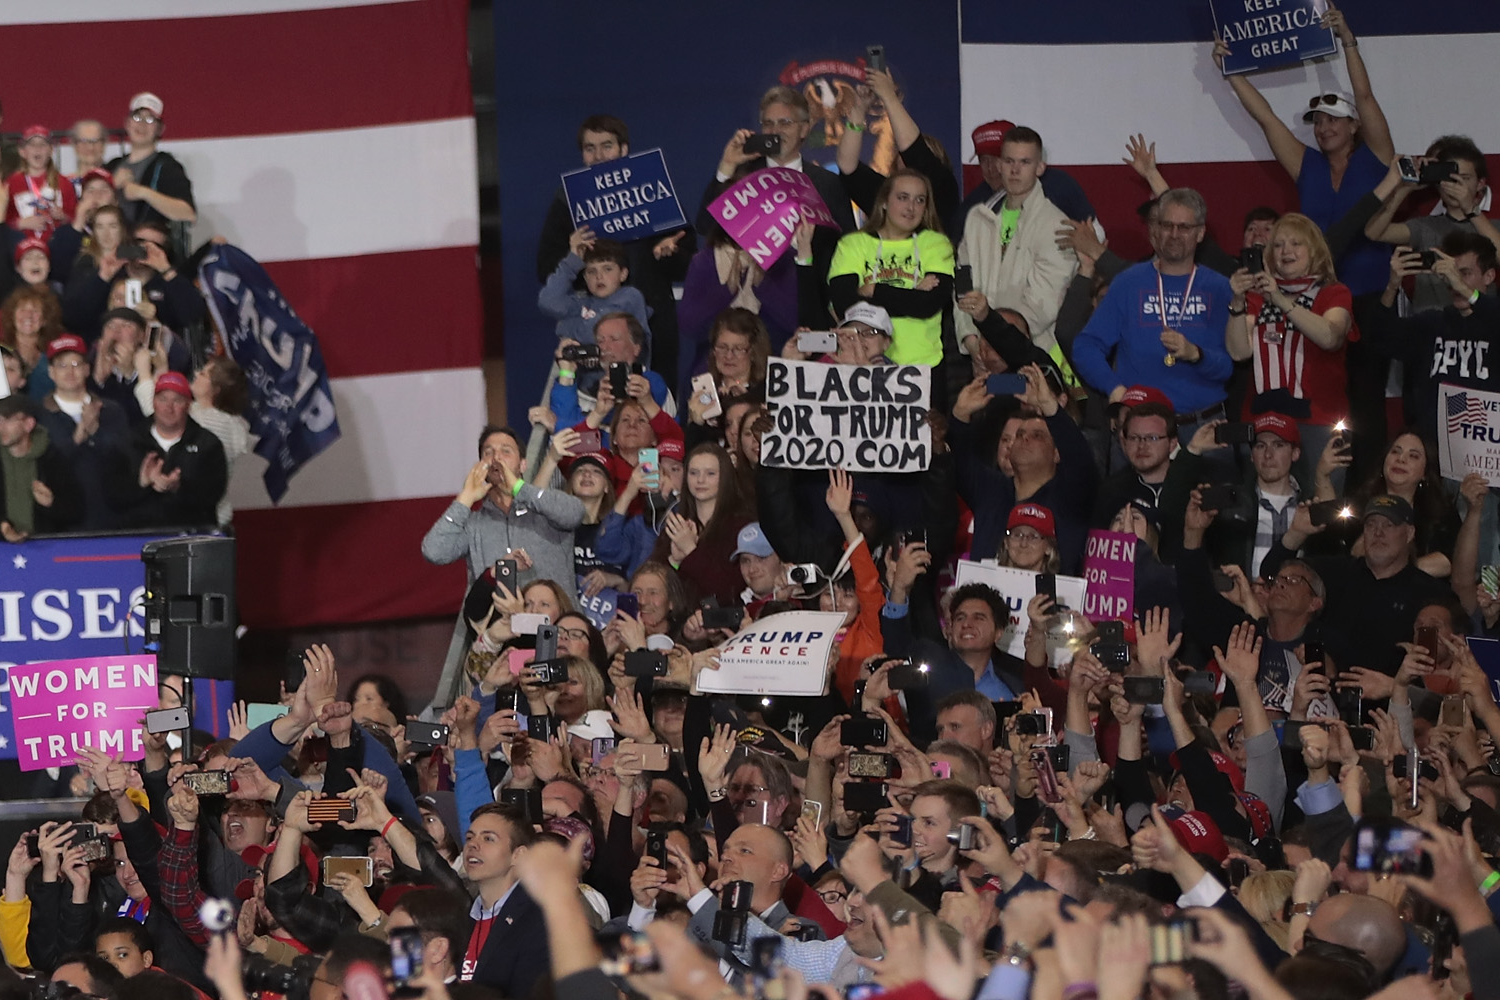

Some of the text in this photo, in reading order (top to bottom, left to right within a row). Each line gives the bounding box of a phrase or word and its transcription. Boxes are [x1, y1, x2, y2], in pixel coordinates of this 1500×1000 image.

[1221, 5, 1324, 42] AMERICA
[1251, 36, 1299, 58] GREAT
[594, 168, 632, 191] KEEP
[575, 179, 673, 223] AMERICA
[722, 170, 810, 221] TRUMP
[603, 210, 651, 234] GREAT
[1143, 302, 1207, 315] SWAMP
[1148, 295, 1180, 304] DIN
[768, 362, 923, 403] BLACKS
[769, 404, 929, 441] FOR TRUMP
[1460, 422, 1500, 444] TRU
[762, 436, 927, 469] 2020.COM
[1086, 536, 1136, 563] OMEN
[1085, 567, 1108, 585] FOR
[580, 594, 612, 615] EEP
[1085, 594, 1128, 618] UMP
[723, 645, 808, 657] PENCE
[726, 631, 824, 647] TRUMP
[10, 663, 156, 698] WOMEN
[57, 702, 107, 722] FOR
[23, 728, 145, 762] TRUMP
